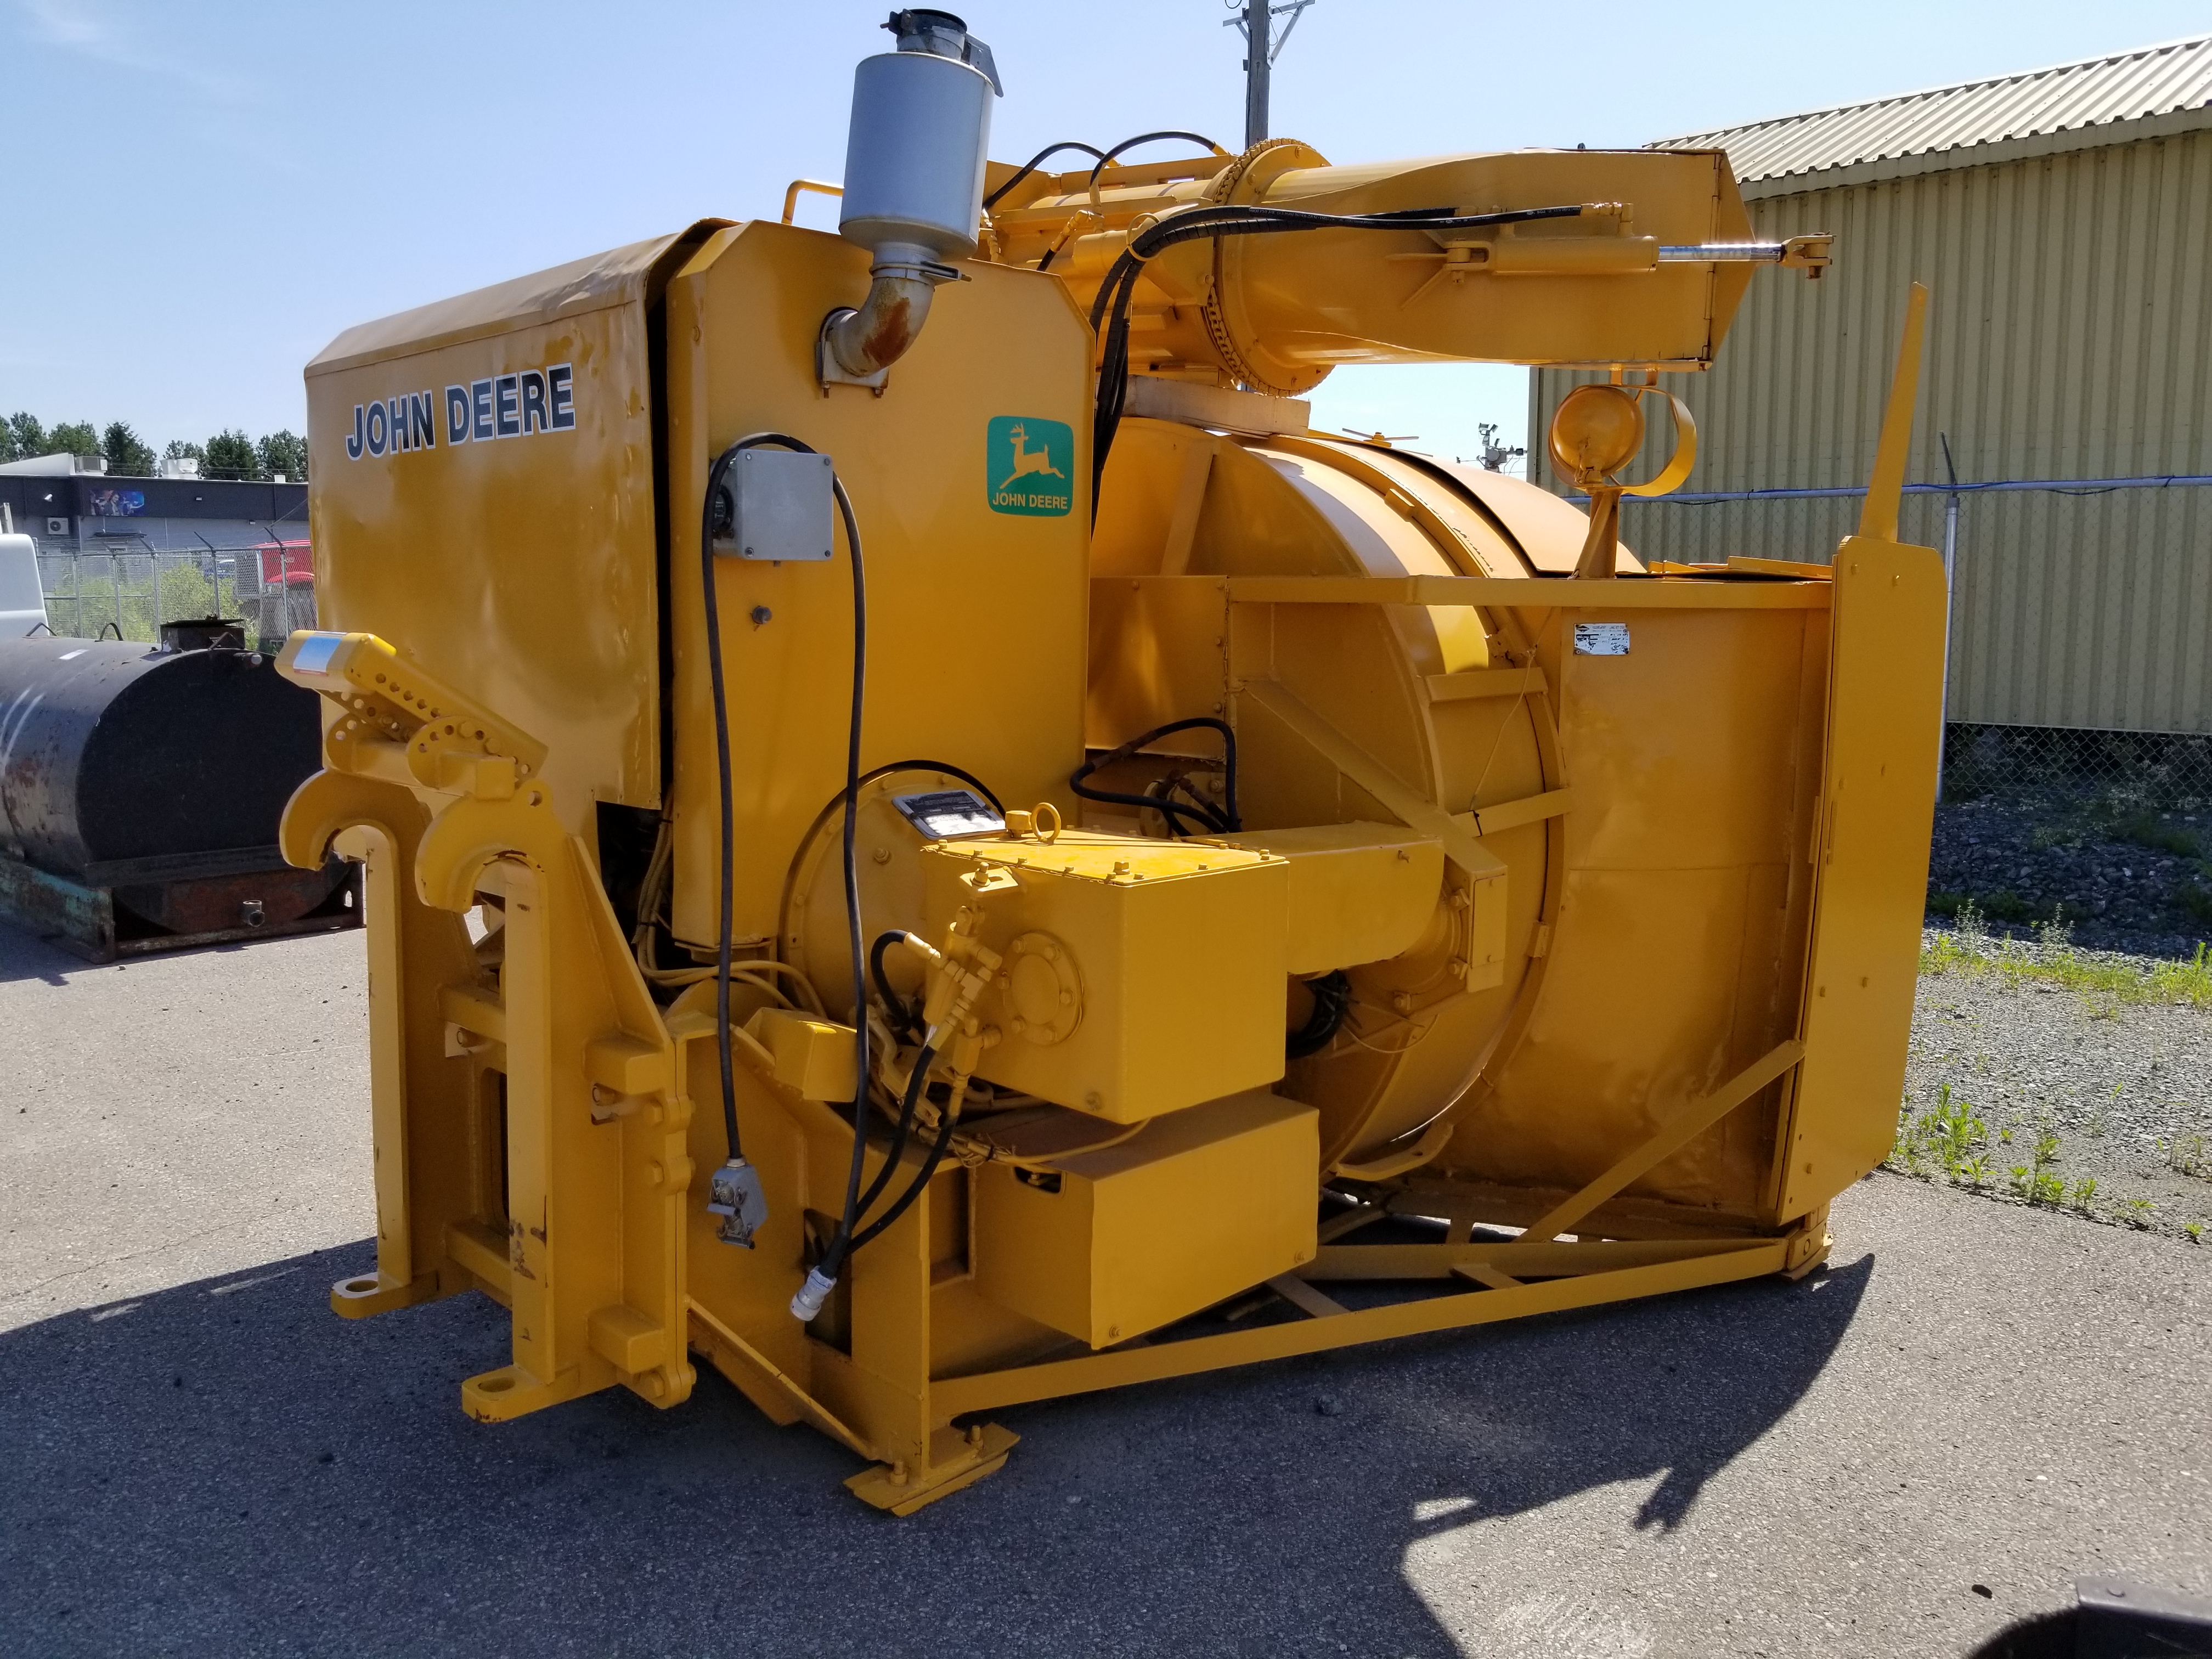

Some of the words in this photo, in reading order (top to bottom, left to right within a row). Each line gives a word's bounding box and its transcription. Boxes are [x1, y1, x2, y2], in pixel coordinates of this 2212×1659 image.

[346, 390, 436, 461] JOHN
[445, 362, 575, 446] DEERE
[992, 492, 1025, 506] JOHN
[1029, 494, 1068, 509] DEERE
